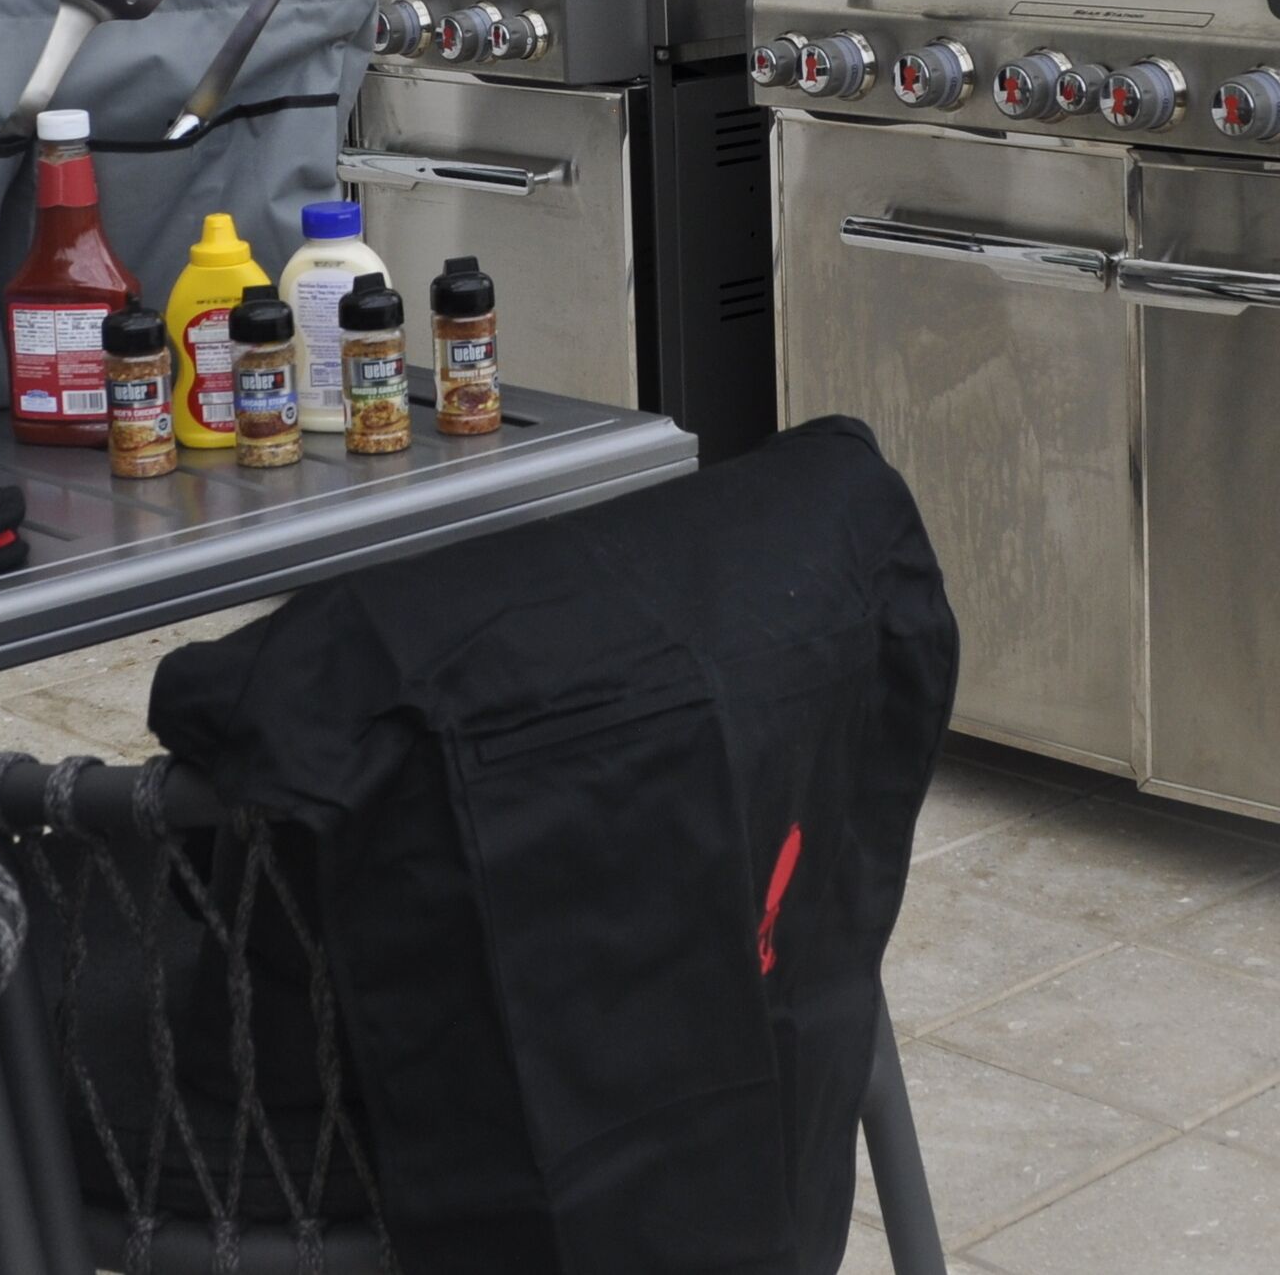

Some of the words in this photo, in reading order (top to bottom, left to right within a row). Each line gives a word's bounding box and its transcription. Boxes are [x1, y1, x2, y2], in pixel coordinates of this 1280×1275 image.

[454, 344, 486, 362] weber
[364, 361, 396, 379] weber
[241, 372, 274, 390] weber
[114, 383, 147, 400] weber
